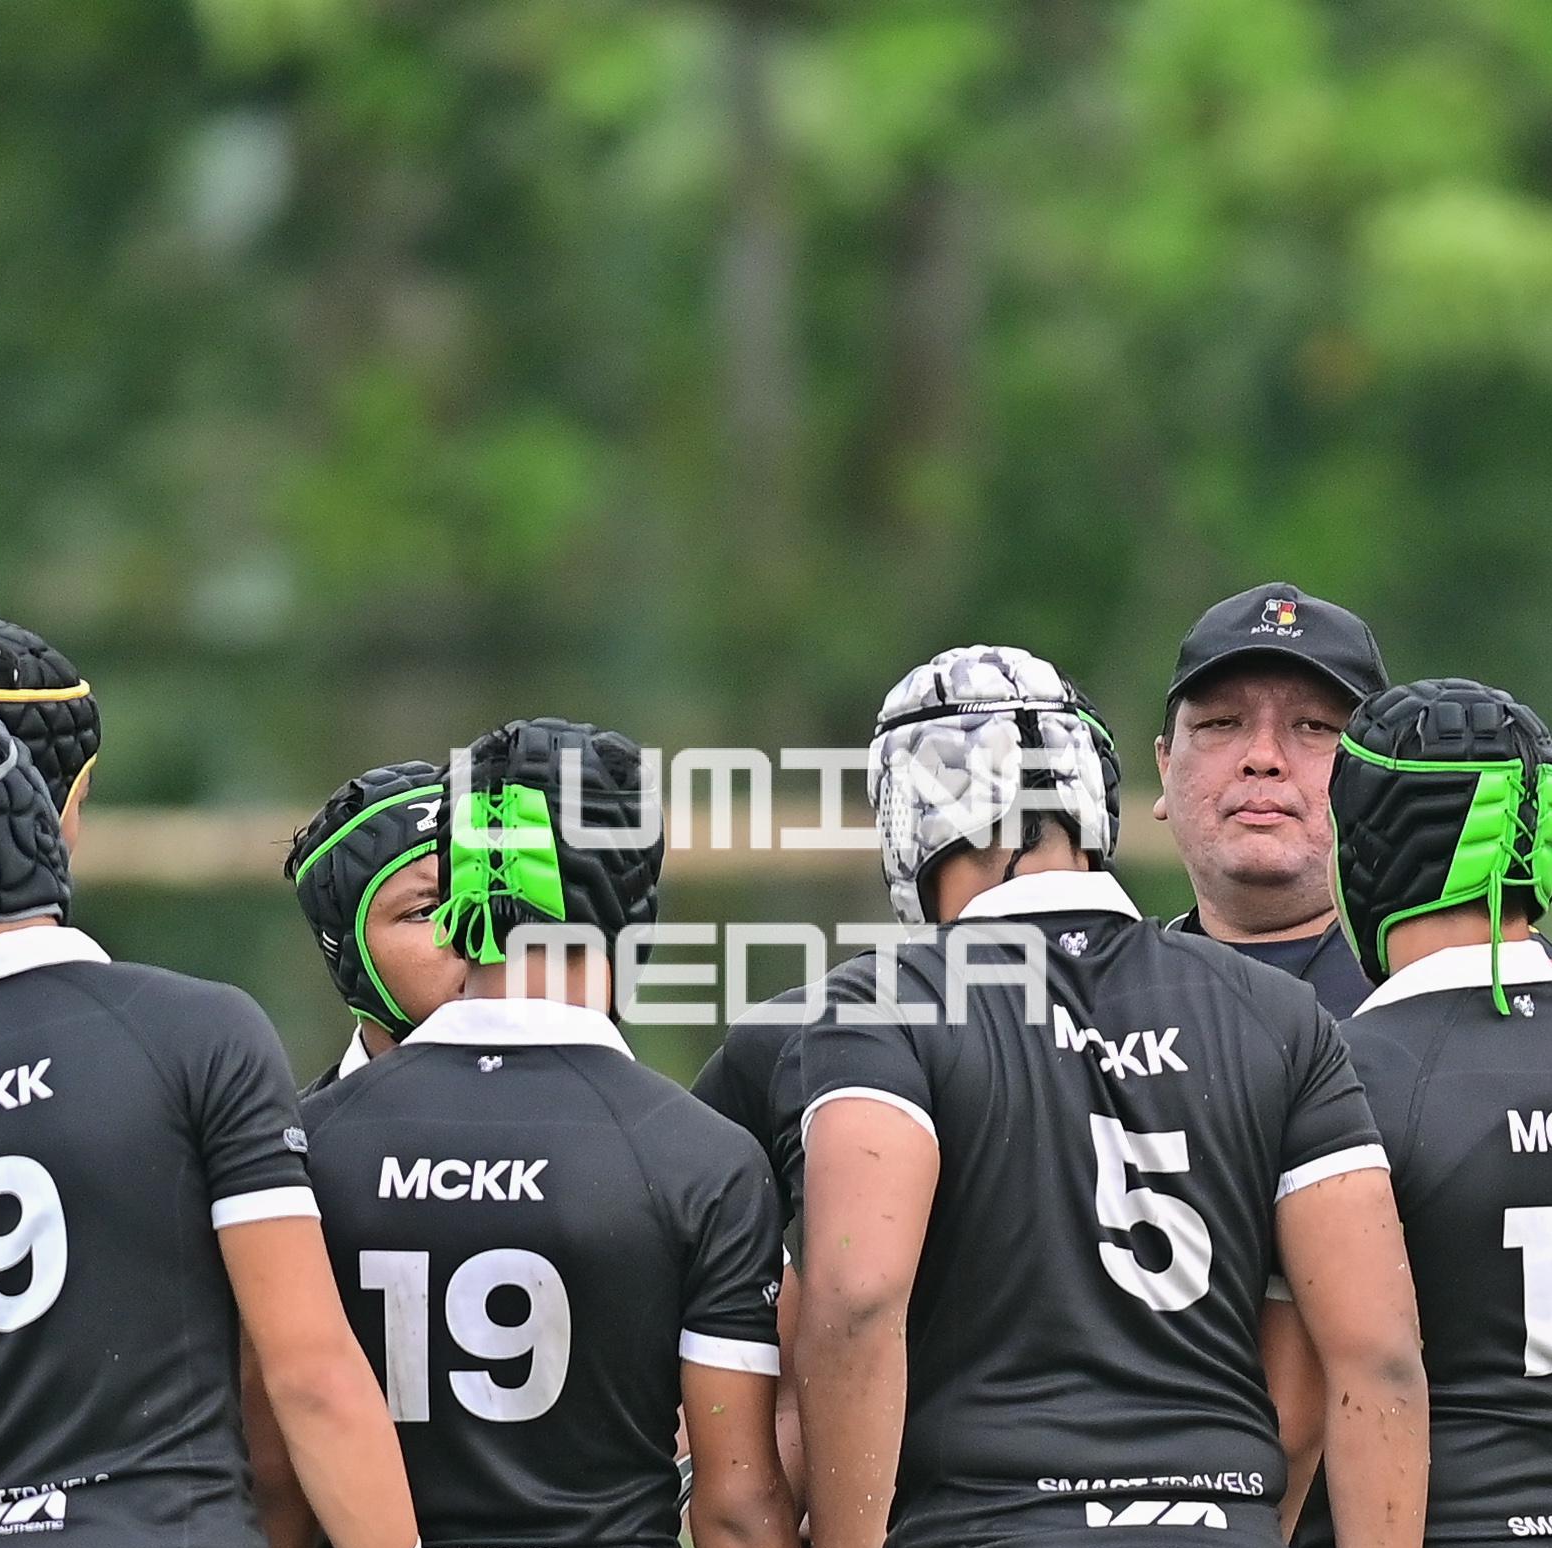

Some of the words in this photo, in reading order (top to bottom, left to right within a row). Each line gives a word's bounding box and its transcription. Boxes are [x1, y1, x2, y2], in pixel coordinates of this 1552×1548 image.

[378, 1156, 549, 1201] MCKK
[1089, 1112, 1213, 1312] 5
[359, 1248, 572, 1422] 19
